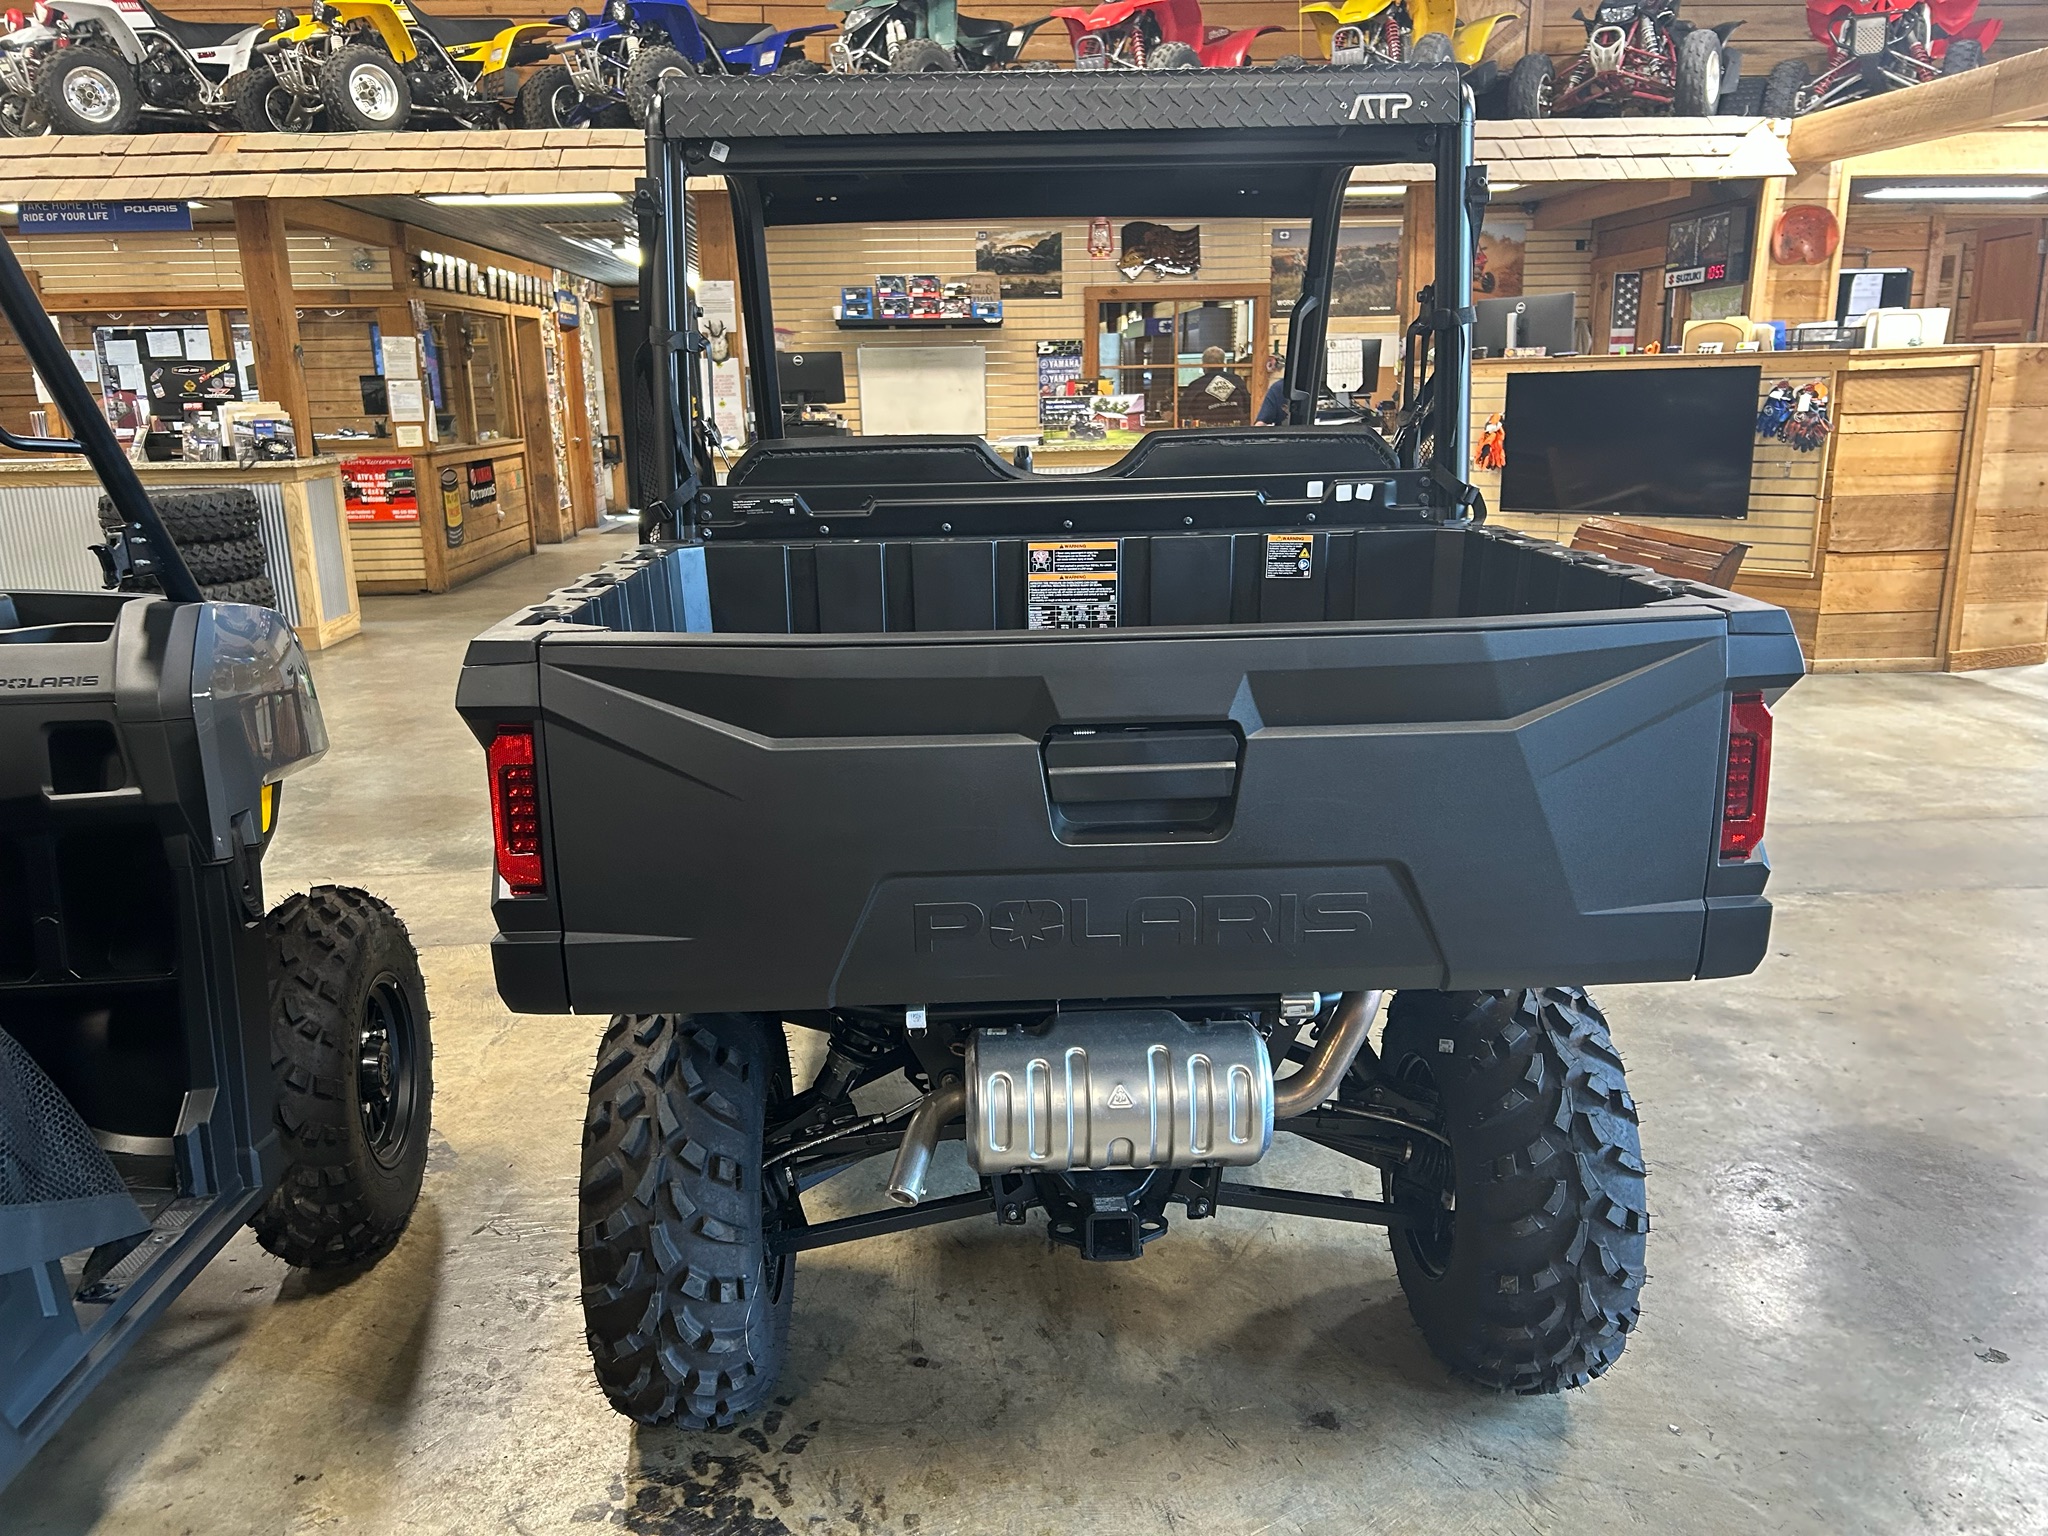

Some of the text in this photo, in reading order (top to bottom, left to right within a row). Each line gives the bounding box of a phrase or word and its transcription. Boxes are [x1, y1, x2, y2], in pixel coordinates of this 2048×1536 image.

[1348, 92, 1413, 120] ATP
[22, 201, 107, 211] TAKE HOME THE
[123, 204, 179, 213] POLARIS
[22, 211, 109, 222] RIDE OF YOUR LIFE
[1675, 271, 1702, 284] SUZUKI
[1048, 358, 1080, 368] YAMAHA
[913, 892, 1373, 953] POLARIS
